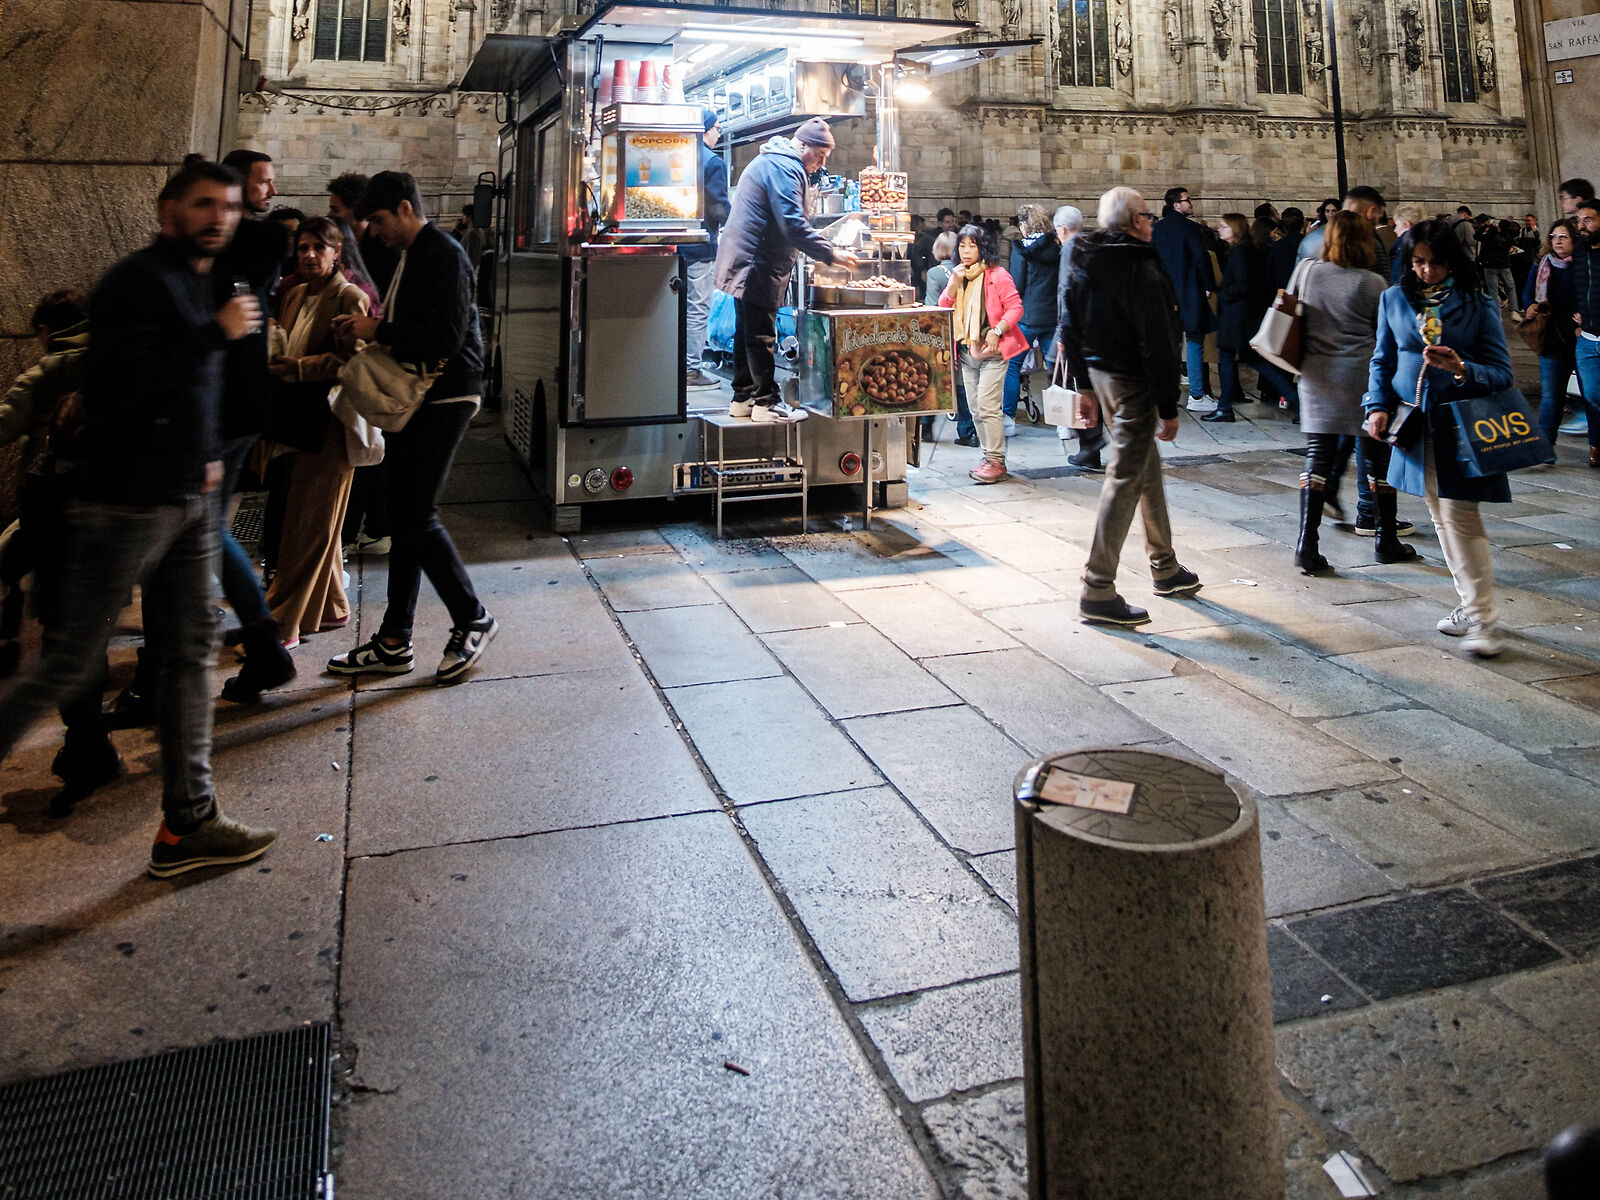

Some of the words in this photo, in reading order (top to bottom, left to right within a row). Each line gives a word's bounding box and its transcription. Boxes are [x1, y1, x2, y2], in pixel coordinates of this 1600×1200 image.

[1571, 19, 1586, 27] VIA
[1548, 41, 1563, 49] SAN
[1568, 34, 1600, 47] RAFFA
[839, 321, 907, 355] Naturalmente
[1474, 412, 1530, 443] OVS
